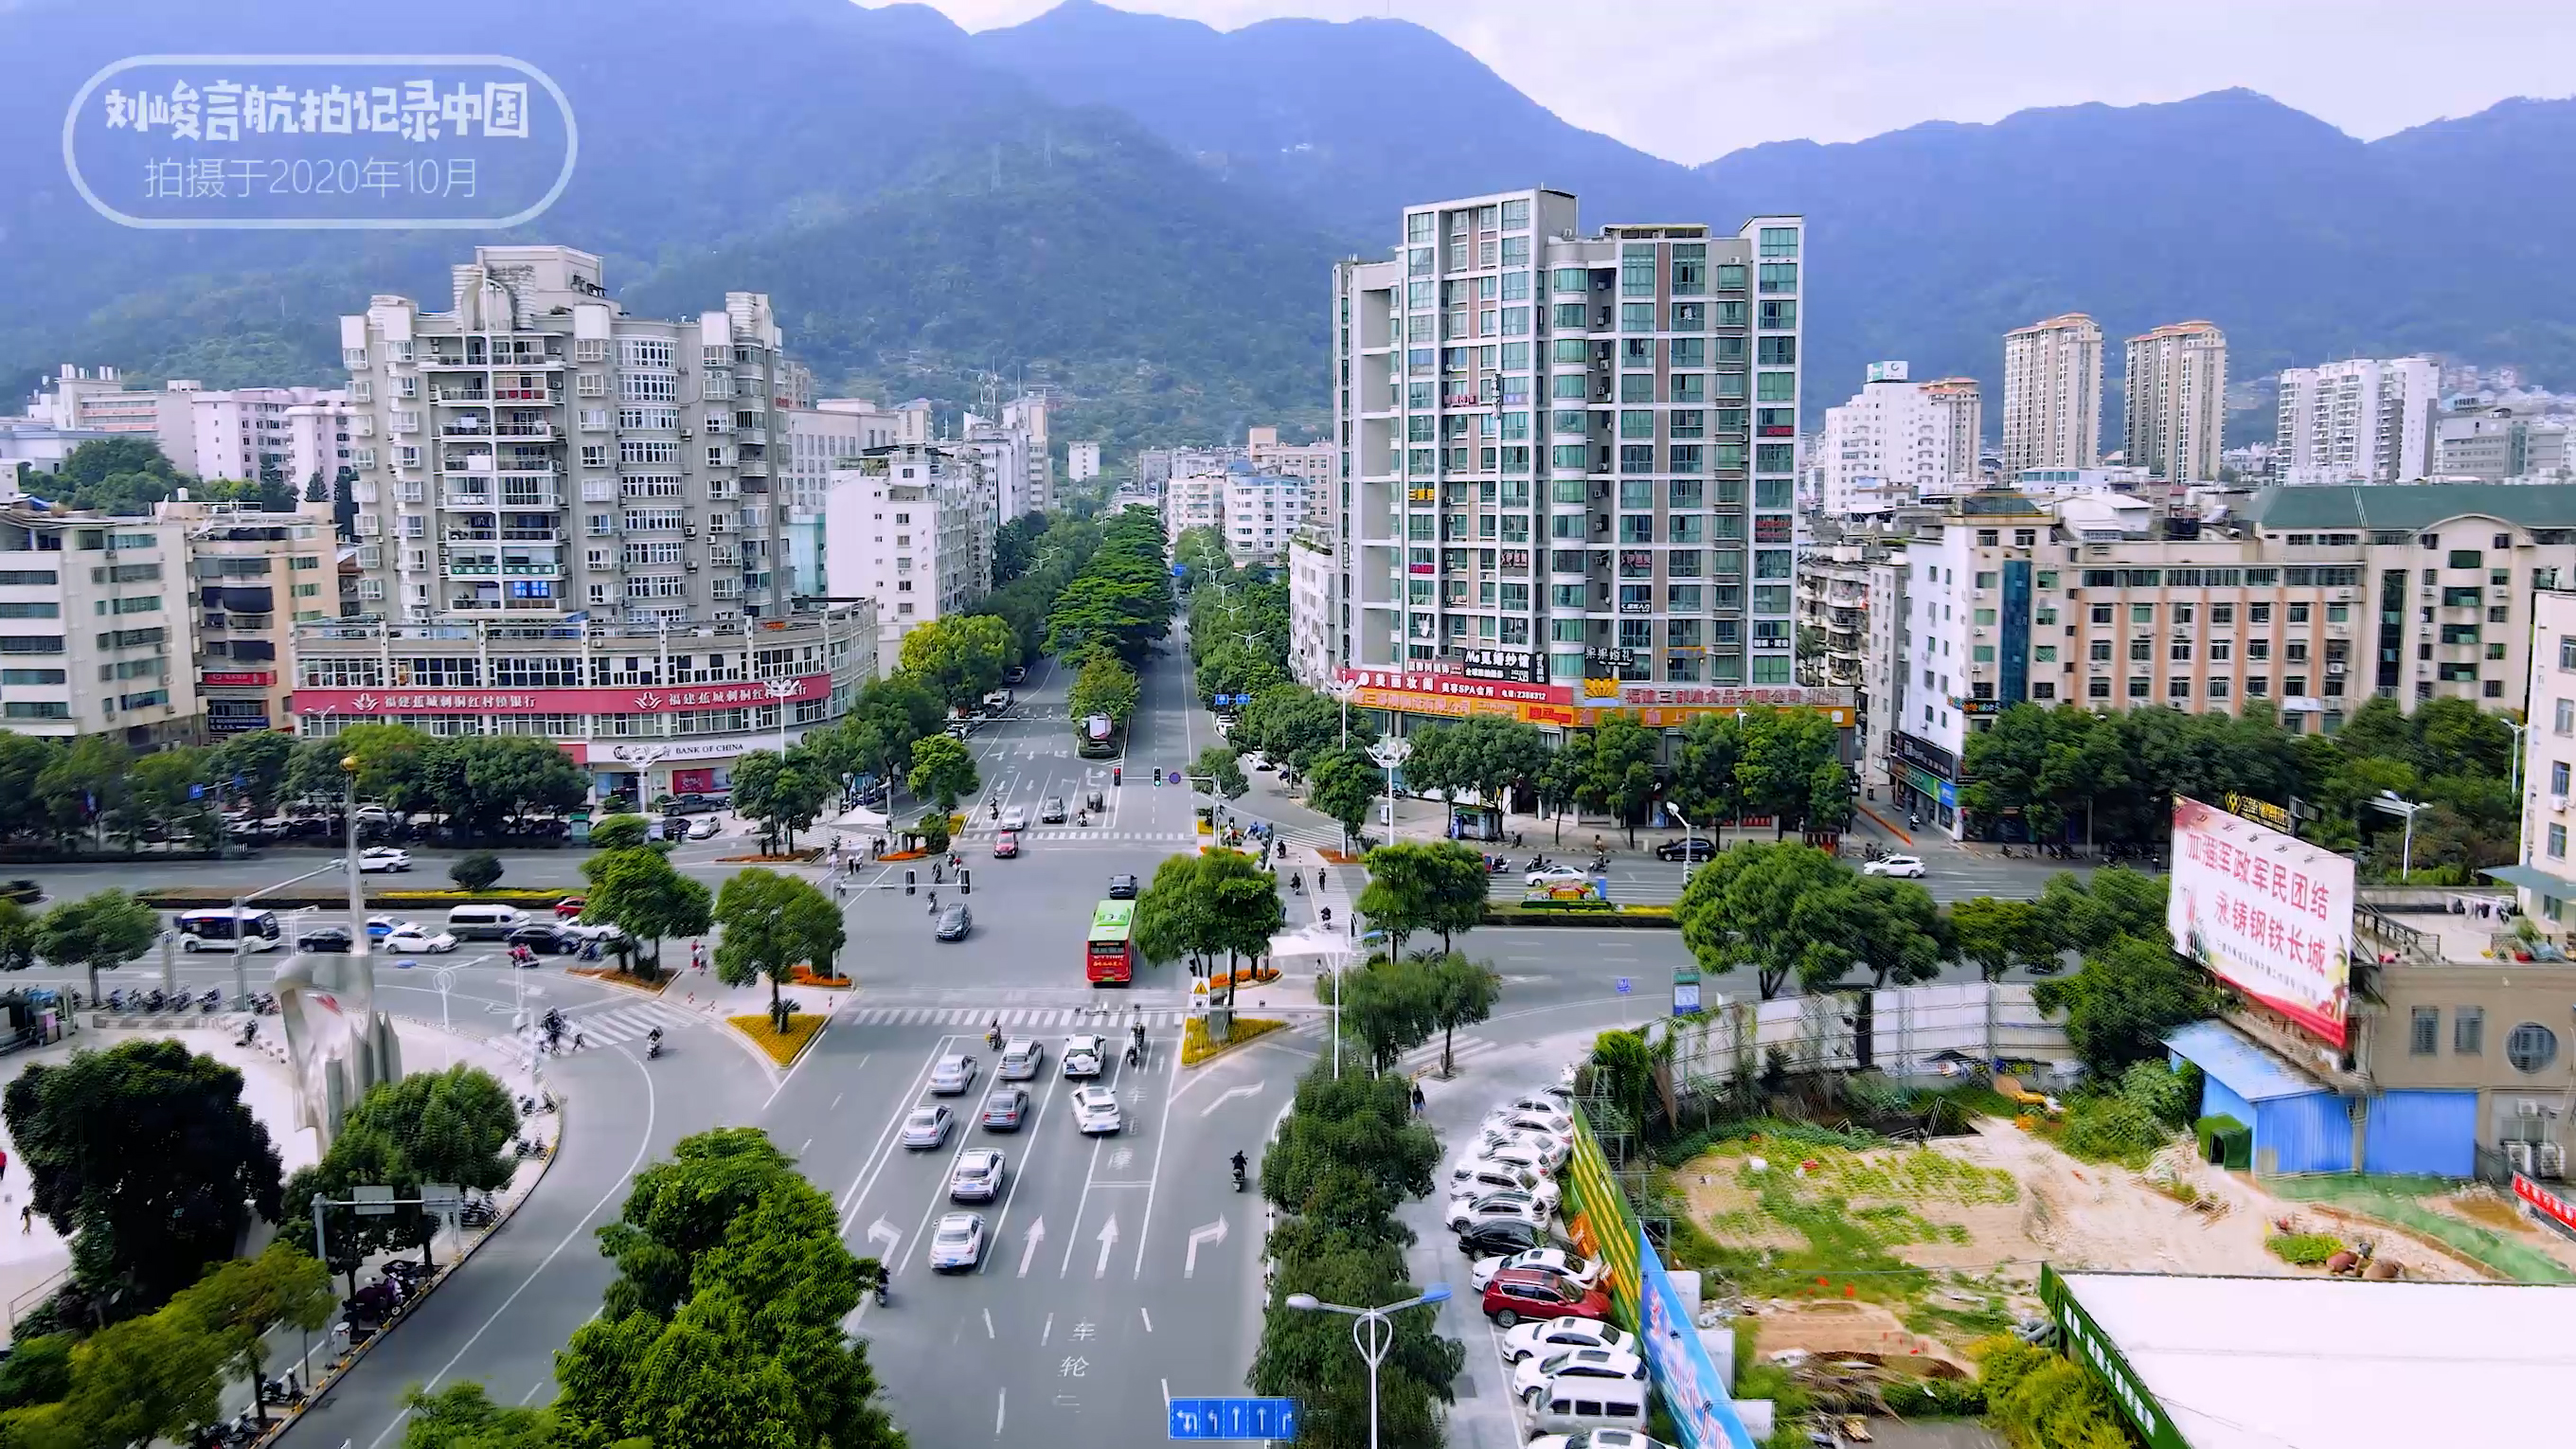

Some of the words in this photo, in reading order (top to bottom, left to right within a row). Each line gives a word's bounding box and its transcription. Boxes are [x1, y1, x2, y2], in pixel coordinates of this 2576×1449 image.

[675, 746, 700, 755] BANK
[702, 745, 714, 754] OF
[716, 743, 744, 753] CHINA
[2185, 827, 2330, 921] 加强军政军民团结
[2213, 890, 2327, 977] 永铸钢铁长城
